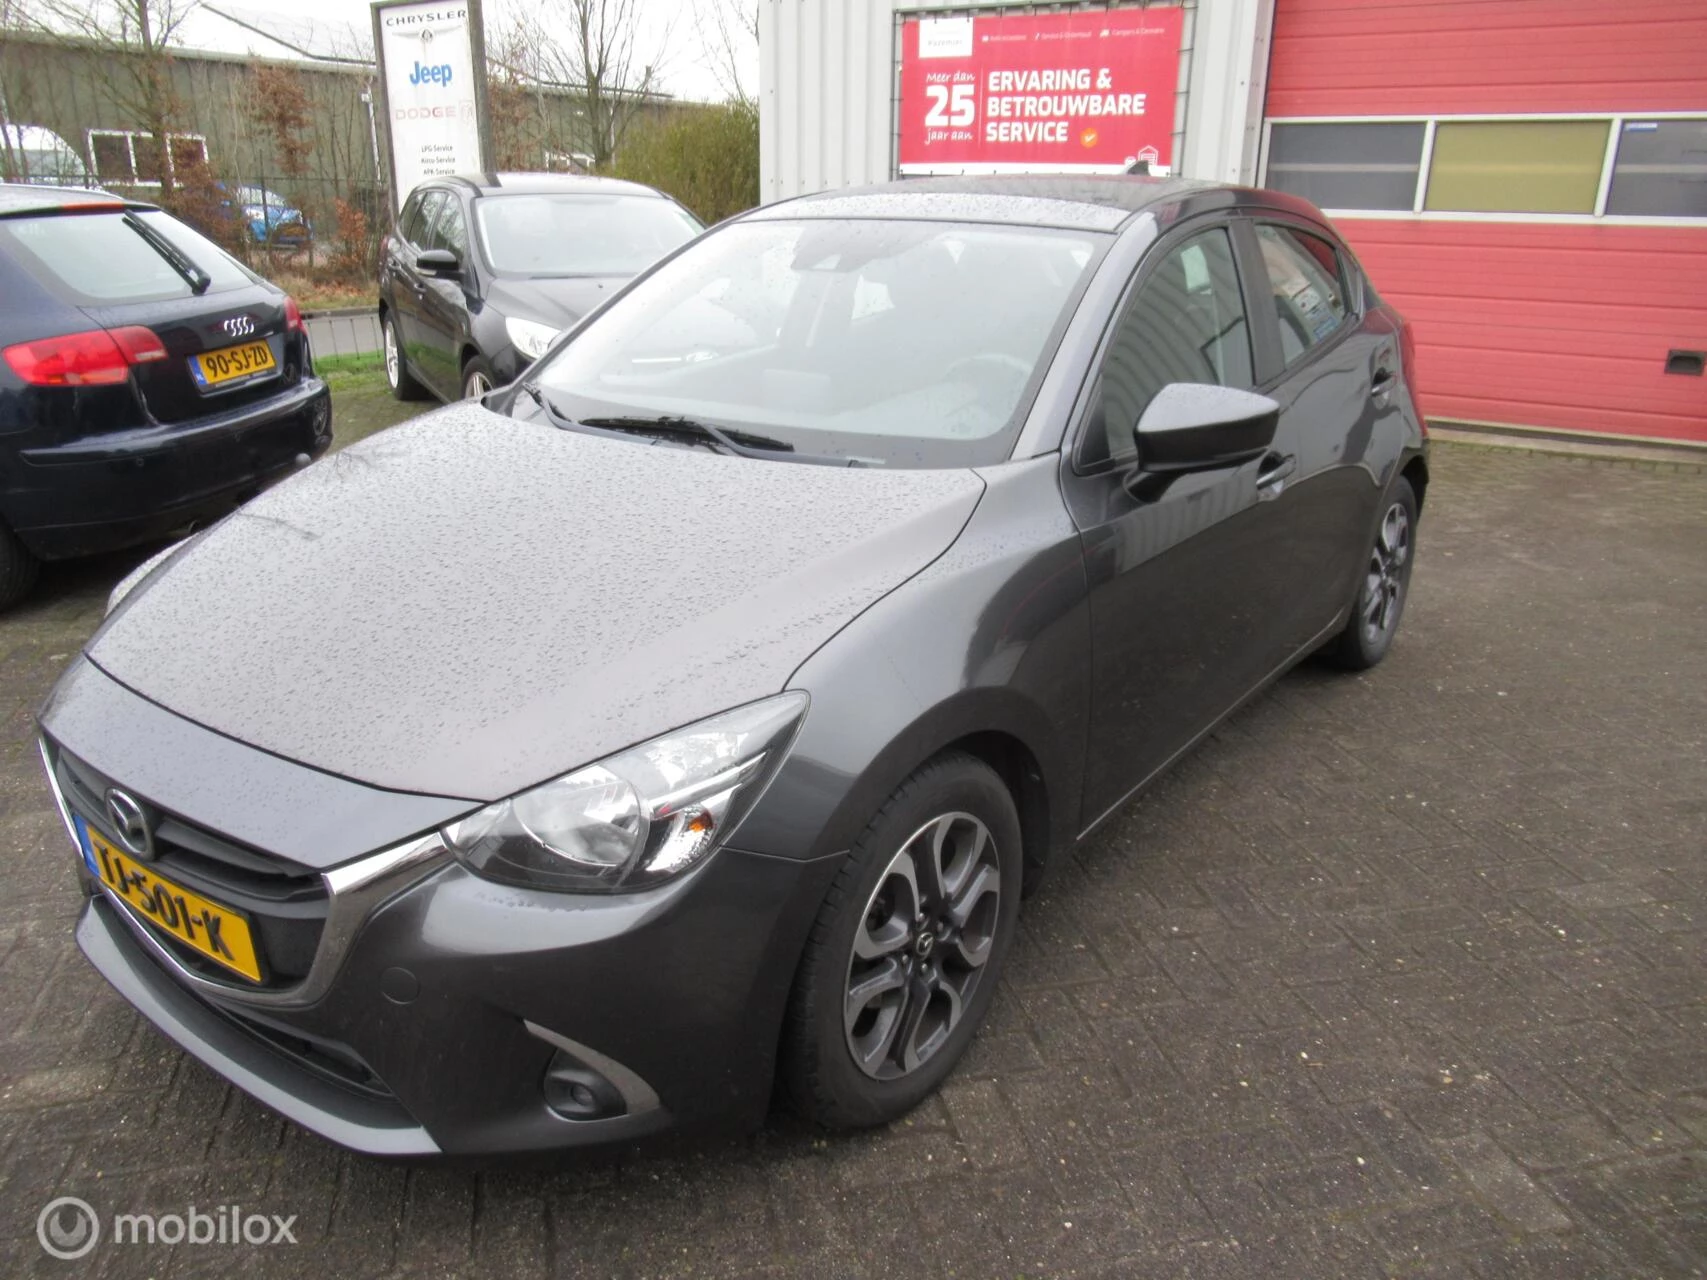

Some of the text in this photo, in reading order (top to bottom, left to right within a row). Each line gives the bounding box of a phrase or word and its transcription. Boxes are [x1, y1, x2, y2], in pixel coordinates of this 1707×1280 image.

[386, 9, 467, 26] CHRYSLER
[409, 60, 453, 87] Jeep
[926, 69, 975, 83] Meer dan
[988, 67, 1112, 92] ERVARING &
[395, 106, 456, 121] DODGE
[924, 84, 976, 127] 25
[986, 93, 1146, 118] BETROUWBARE
[924, 128, 973, 145] jaar aan
[985, 121, 1069, 143] SERVICE
[205, 345, 268, 378] 90-SJ-ZD
